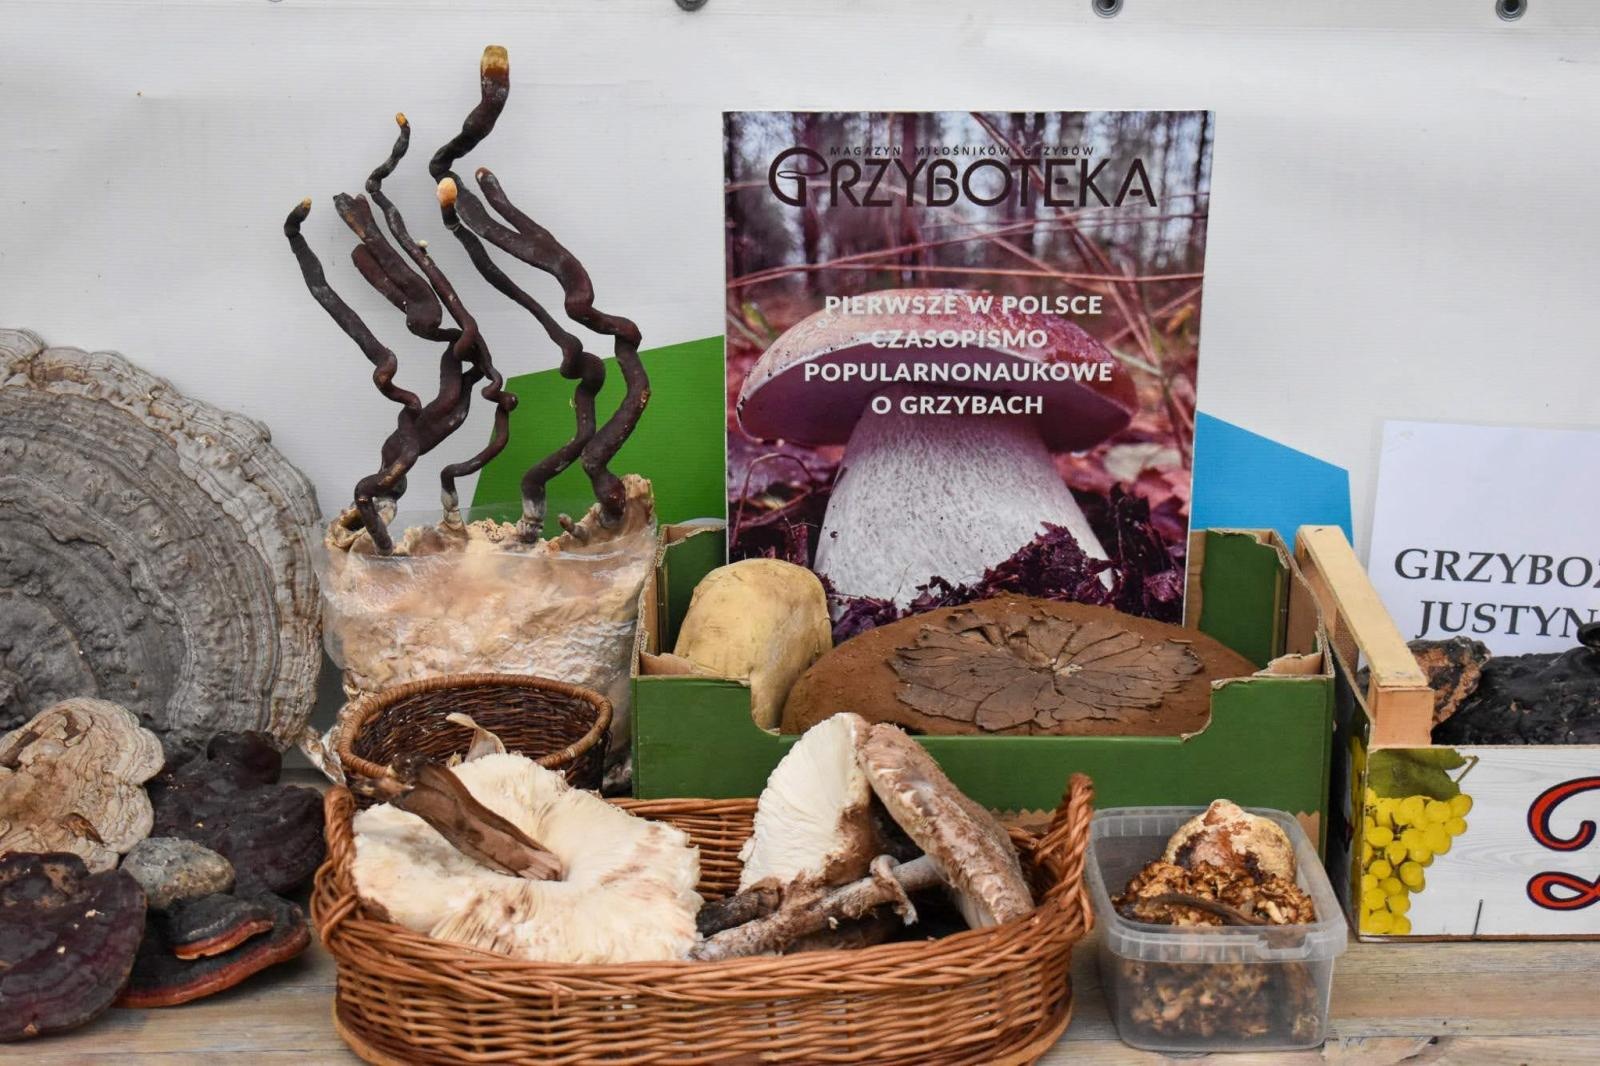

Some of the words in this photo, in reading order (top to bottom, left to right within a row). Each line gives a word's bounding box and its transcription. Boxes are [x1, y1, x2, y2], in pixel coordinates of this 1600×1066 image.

[830, 146, 901, 156] MAGAZYN
[914, 144, 1010, 156] MIŁOŚNIKÓW
[1023, 144, 1095, 156] GRZYBÓW
[768, 147, 1157, 207] GRZYBOTEKA
[825, 295, 957, 315] PIERWSZE
[967, 295, 994, 315] W
[1002, 295, 1103, 315] POLSCE
[871, 329, 1048, 349] CZASOPISMO
[804, 362, 1113, 382] POPULARNONAUKOWE
[871, 396, 892, 415] O
[900, 396, 1043, 415] GRZYBACH
